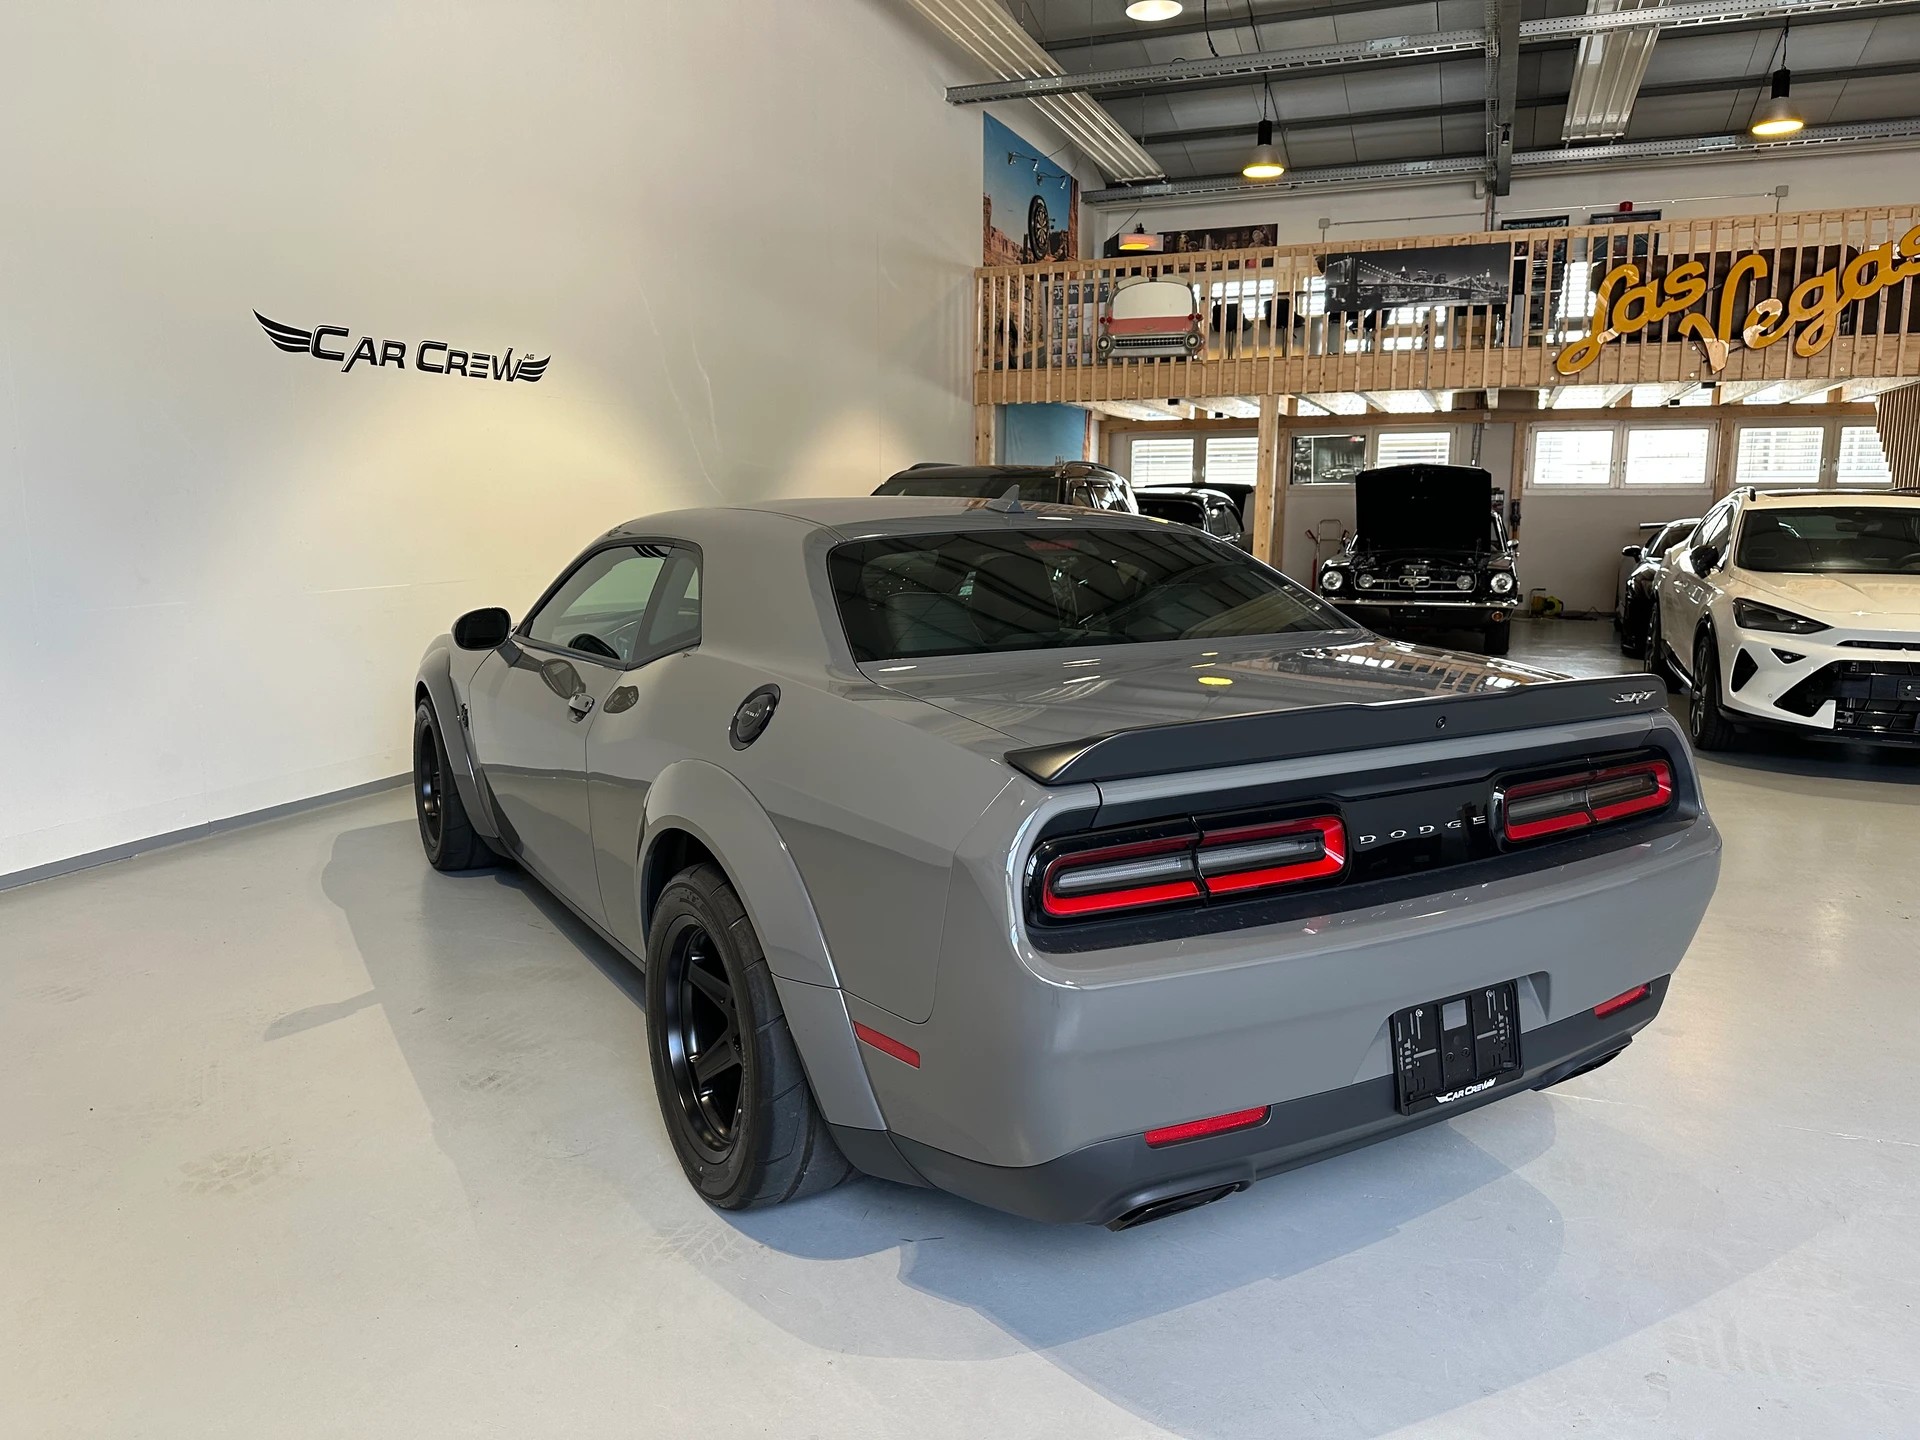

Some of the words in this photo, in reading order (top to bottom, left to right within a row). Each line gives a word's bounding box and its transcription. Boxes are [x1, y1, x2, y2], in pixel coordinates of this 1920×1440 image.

[1556, 260, 1707, 376] Las
[310, 324, 407, 373] CAR
[415, 340, 522, 383] CREW
[1613, 690, 1657, 705] SRT
[1359, 815, 1486, 845] DODGE
[1445, 1089, 1465, 1102] CAR
